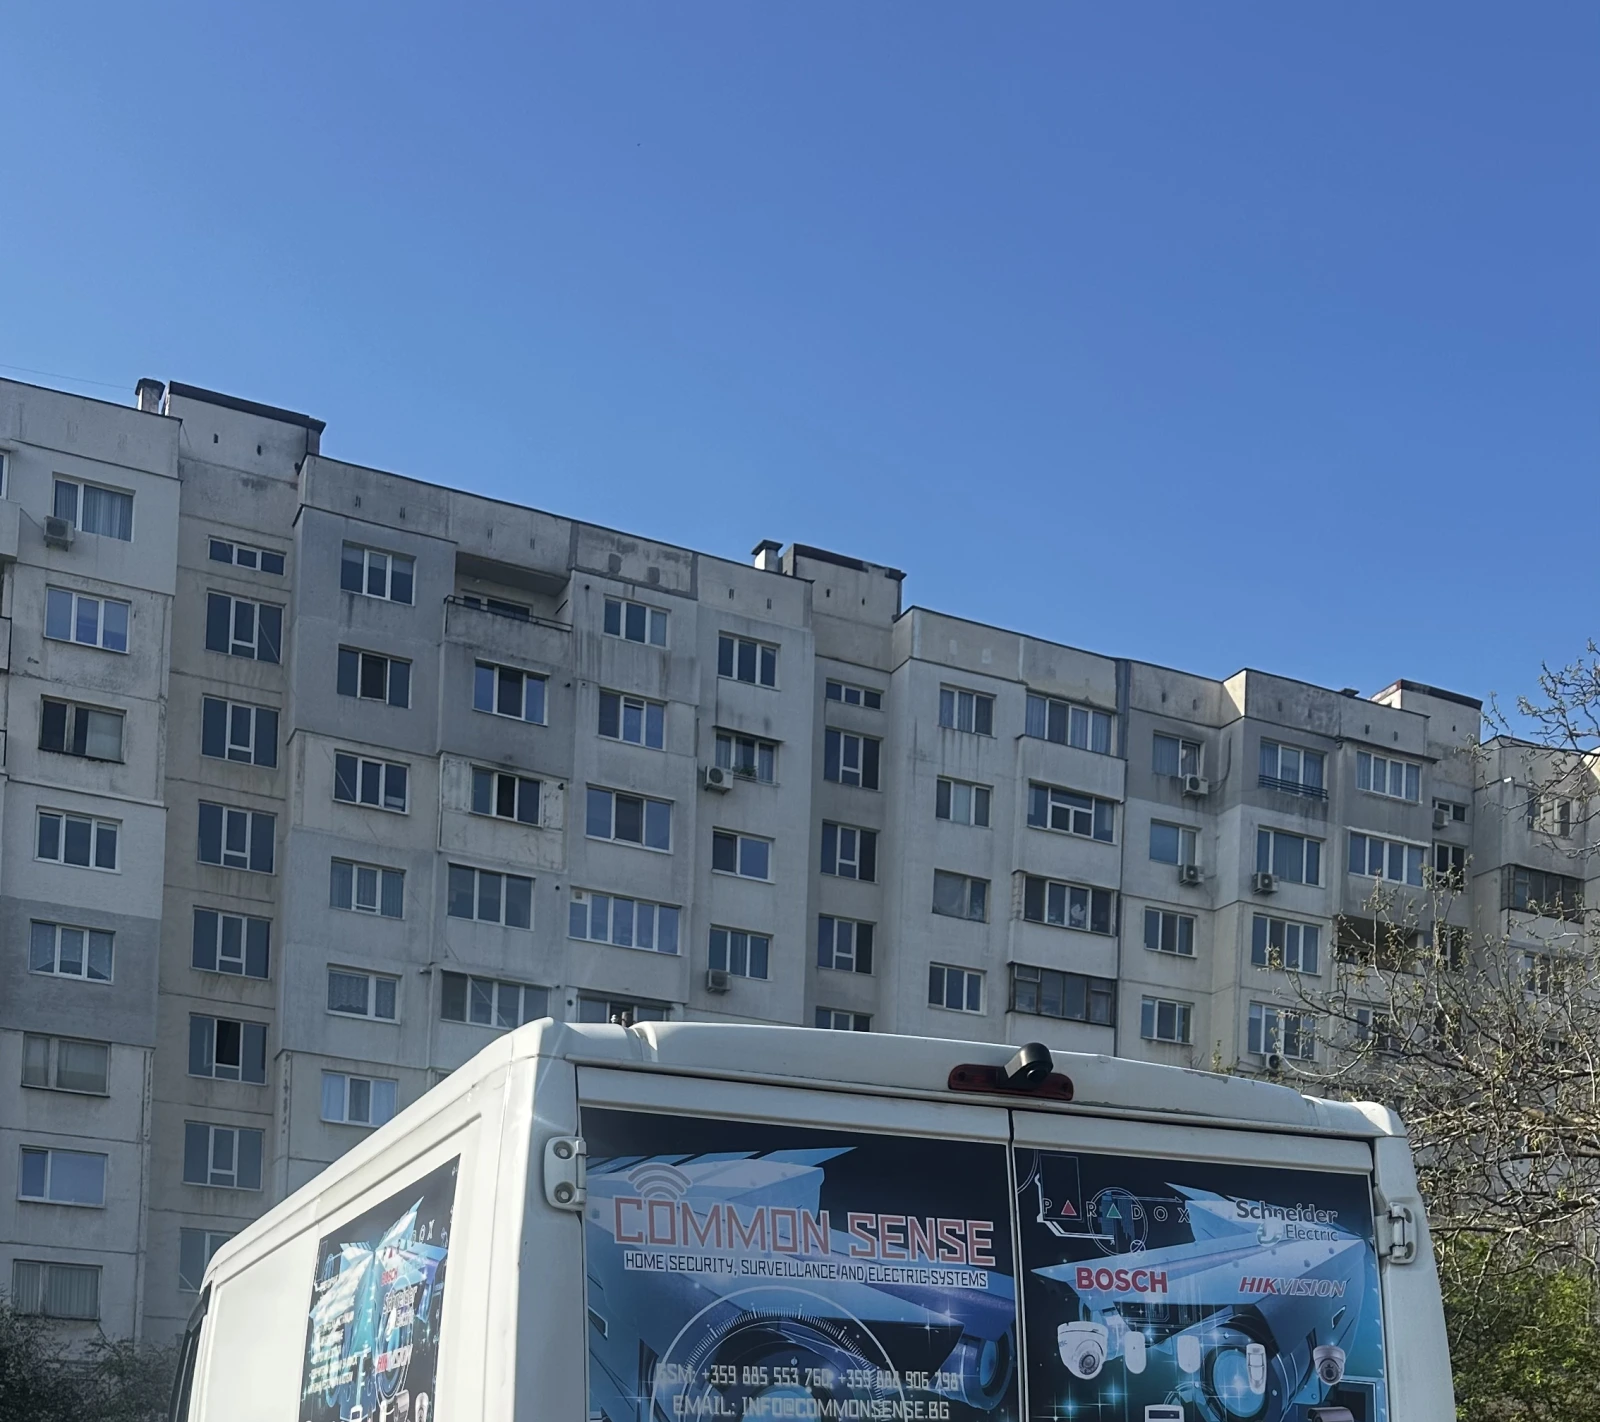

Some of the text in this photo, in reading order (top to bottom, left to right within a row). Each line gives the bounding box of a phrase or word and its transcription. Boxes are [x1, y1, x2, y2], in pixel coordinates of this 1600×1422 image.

[1236, 1199, 1338, 1224] Schneider
[613, 1195, 996, 1267] COMMON SENSE
[1285, 1224, 1338, 1242] Electric
[625, 1253, 987, 1287] HOME SECURITY, SURVEILLANCE AND ELECTRIC SYSTEMS
[1075, 1266, 1169, 1294] BOSCH
[1238, 1275, 1347, 1297] HIKVISION
[702, 1364, 737, 1384] +359
[742, 1366, 768, 1386] 885
[773, 1366, 799, 1386] 553
[838, 1369, 871, 1388] +359
[905, 1371, 928, 1389] 906
[673, 1395, 949, 1419] EMAIL: INFO@COMMONSENSE.BG
